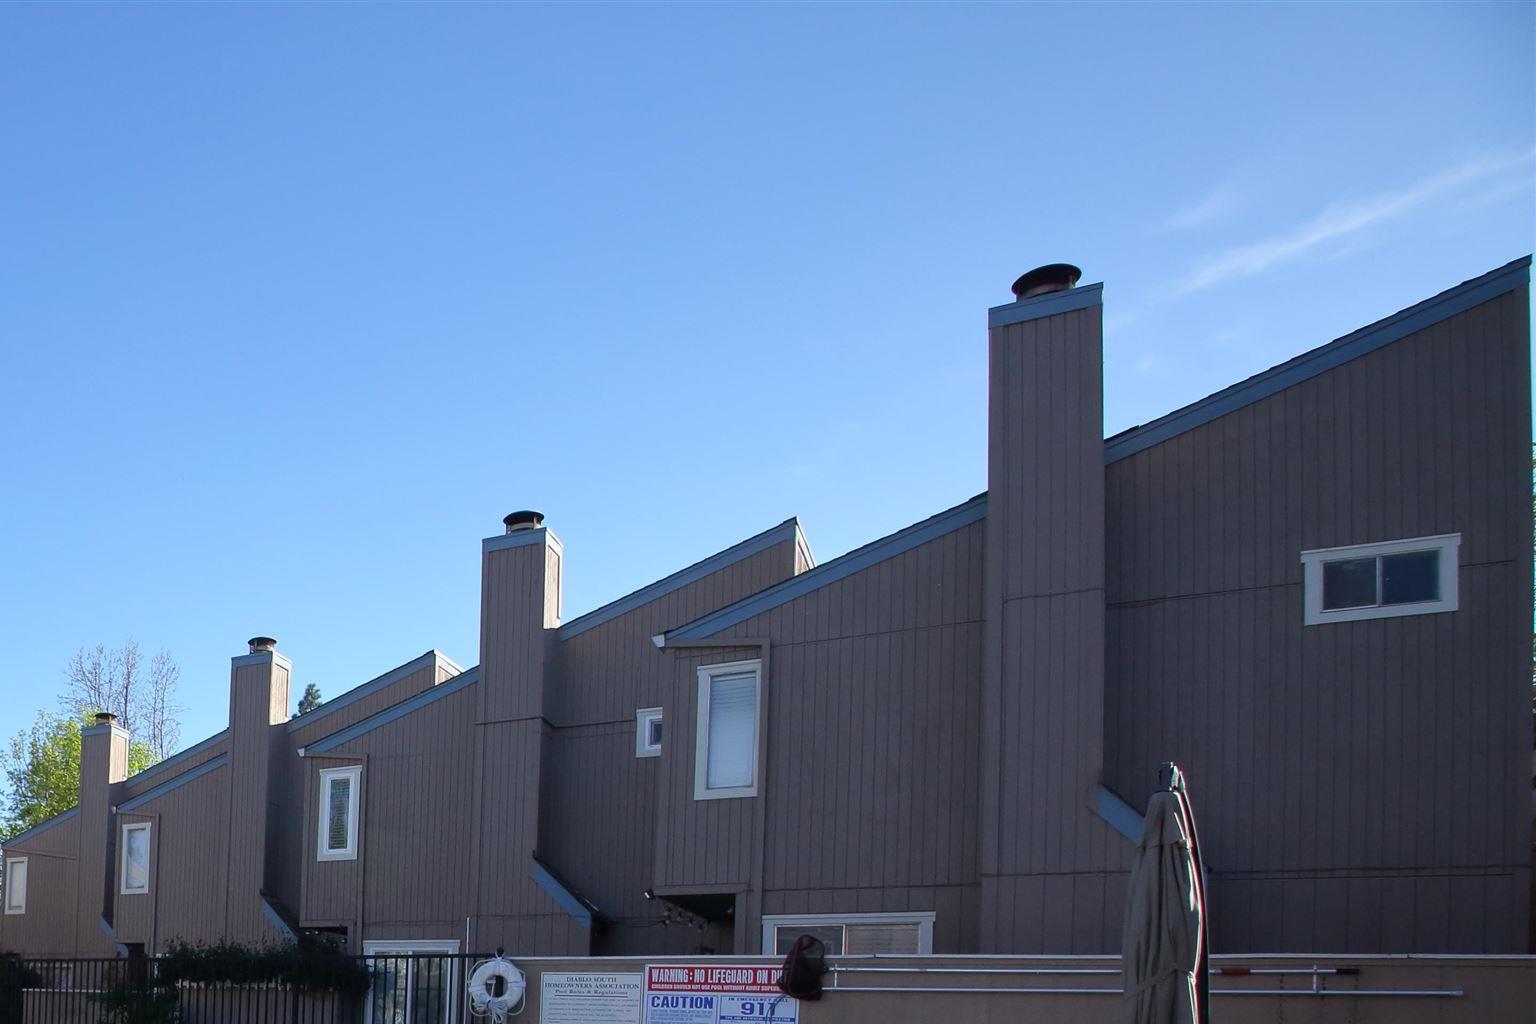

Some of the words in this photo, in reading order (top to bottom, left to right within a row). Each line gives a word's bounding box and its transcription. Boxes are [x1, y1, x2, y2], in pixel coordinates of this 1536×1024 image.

[694, 969, 705, 983] NO
[707, 969, 753, 984] LIFEGUARD
[756, 970, 768, 984] ON
[651, 995, 714, 1009] CAUTION
[741, 1001, 774, 1016] 911
